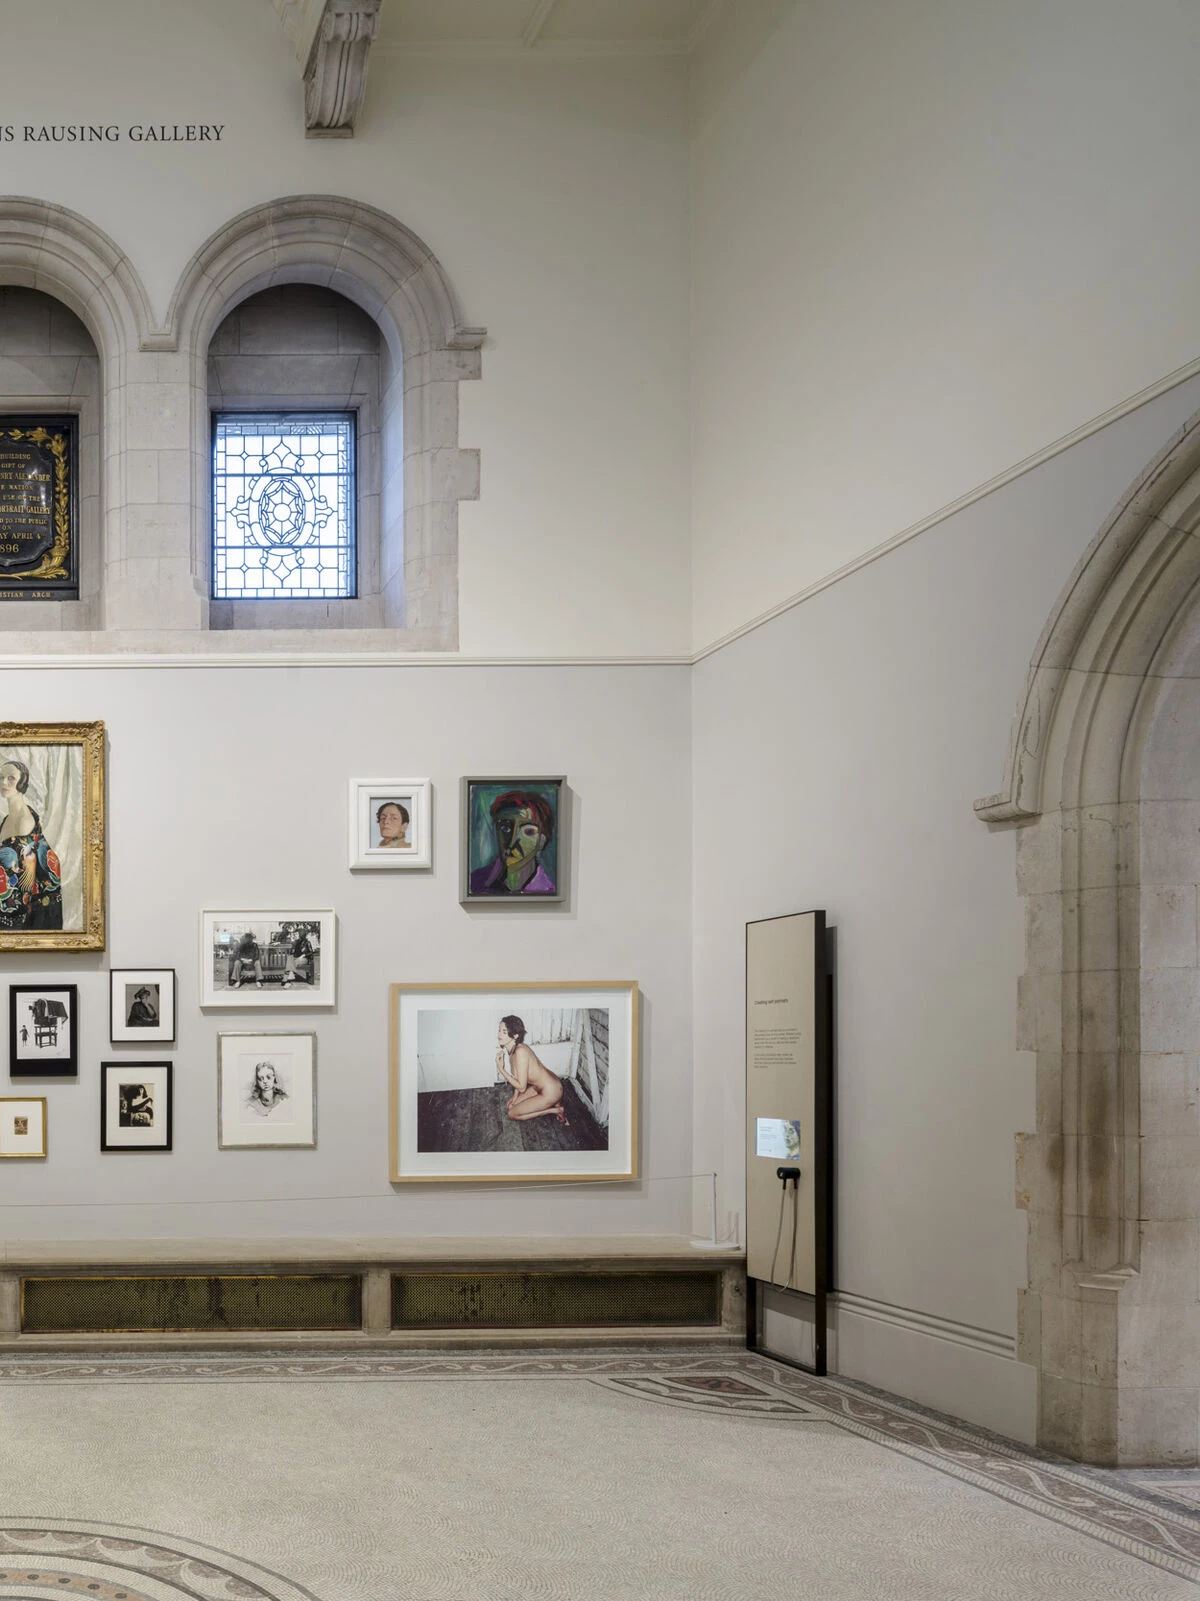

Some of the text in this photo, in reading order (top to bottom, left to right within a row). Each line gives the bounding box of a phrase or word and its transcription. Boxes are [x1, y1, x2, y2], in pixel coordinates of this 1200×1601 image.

[23, 125, 120, 141] RAUSING
[129, 125, 225, 141] GALLERY
[14, 472, 51, 482] ALEXANDER
[26, 506, 51, 515] GALLERY
[11, 532, 33, 540] APRIL
